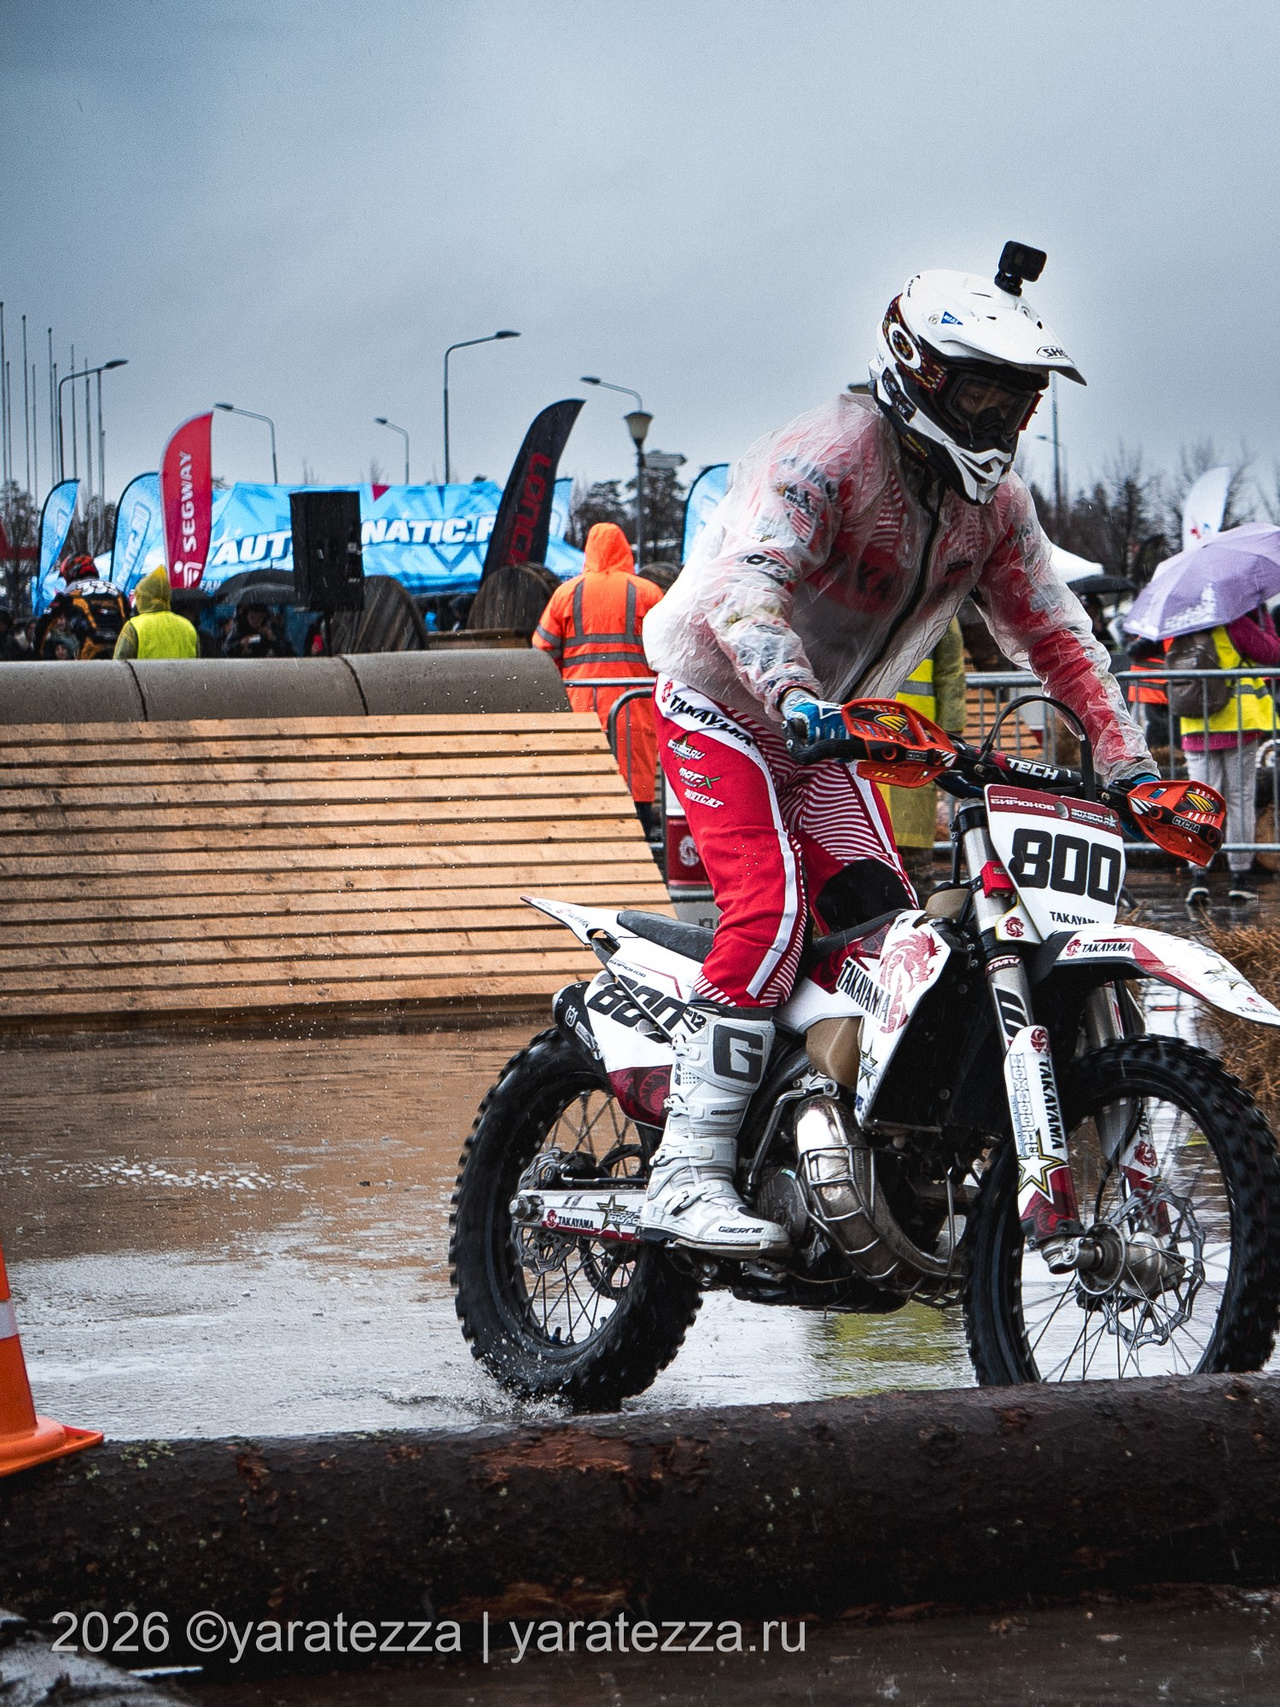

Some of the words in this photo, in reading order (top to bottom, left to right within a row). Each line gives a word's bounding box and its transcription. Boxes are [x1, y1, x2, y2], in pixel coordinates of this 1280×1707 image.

[179, 451, 198, 553] SEGWAY
[990, 798, 1056, 812] БИРЮКОВ
[1172, 815, 1201, 834] CYCRA
[1008, 828, 1122, 907] 800
[1081, 942, 1131, 954] TAKAYAMA
[836, 959, 892, 1024] TAKAYAMA
[1037, 1059, 1065, 1150] TAKAYAMA
[557, 1216, 595, 1230] TAKAYAMA
